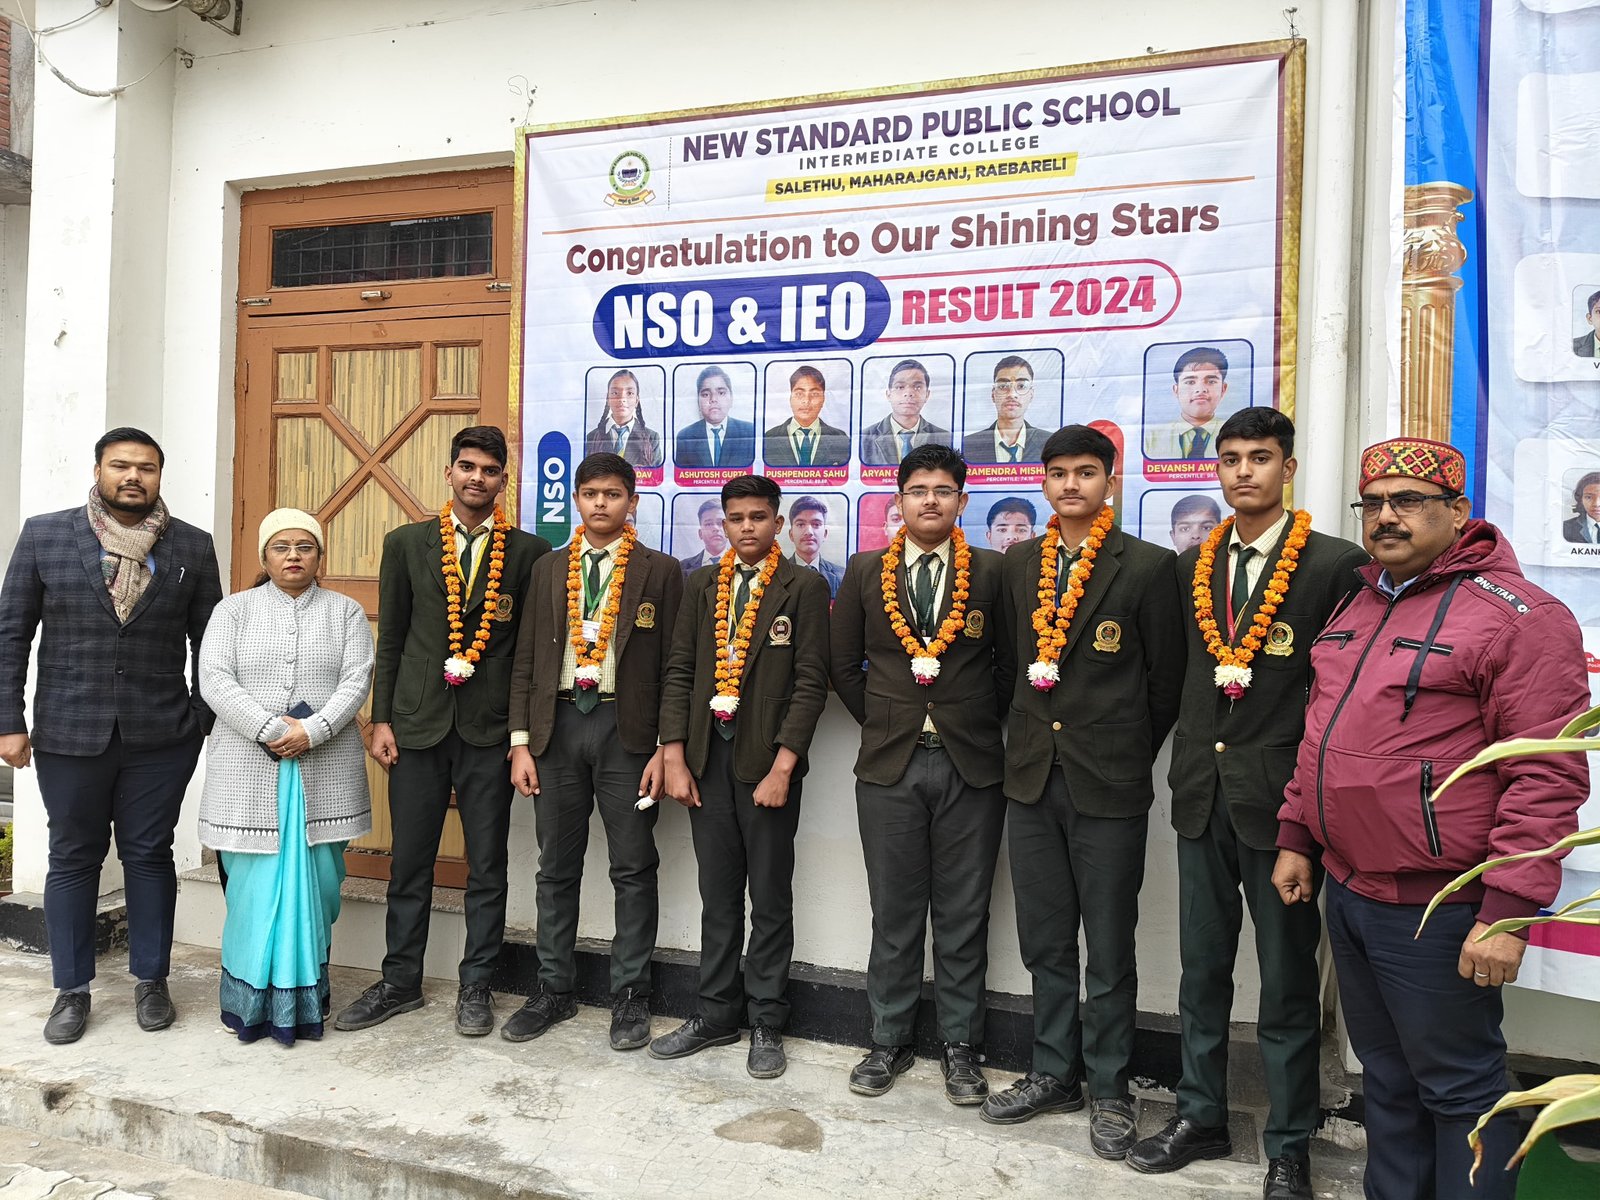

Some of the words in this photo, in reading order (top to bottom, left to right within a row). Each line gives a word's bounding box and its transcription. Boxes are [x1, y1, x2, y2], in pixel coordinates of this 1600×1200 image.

[683, 131, 748, 162] NEW
[755, 115, 913, 156] STANDARD
[922, 102, 1033, 140] PUBLIC
[1042, 87, 1181, 127] SCHOOL
[775, 179, 845, 195] SALETHU,
[849, 165, 971, 189] MAHARAJGANJ,
[976, 157, 1067, 178] RAEBARELI
[799, 146, 938, 170] INTERMEDIATE
[949, 135, 1040, 157] COLLEGE
[567, 230, 811, 275] Congratulation
[823, 227, 860, 257] to
[871, 221, 940, 254] Our
[950, 208, 1098, 249] Shining
[1110, 201, 1219, 237] Stars
[613, 290, 713, 349] NSO
[727, 296, 766, 345] &
[780, 281, 866, 342] IEO
[902, 281, 1040, 326] RESULT
[1049, 275, 1157, 317] 2024
[542, 456, 565, 523] NSO
[766, 470, 821, 478] PUSHPENDRA
[1147, 464, 1195, 473] DEVANSH
